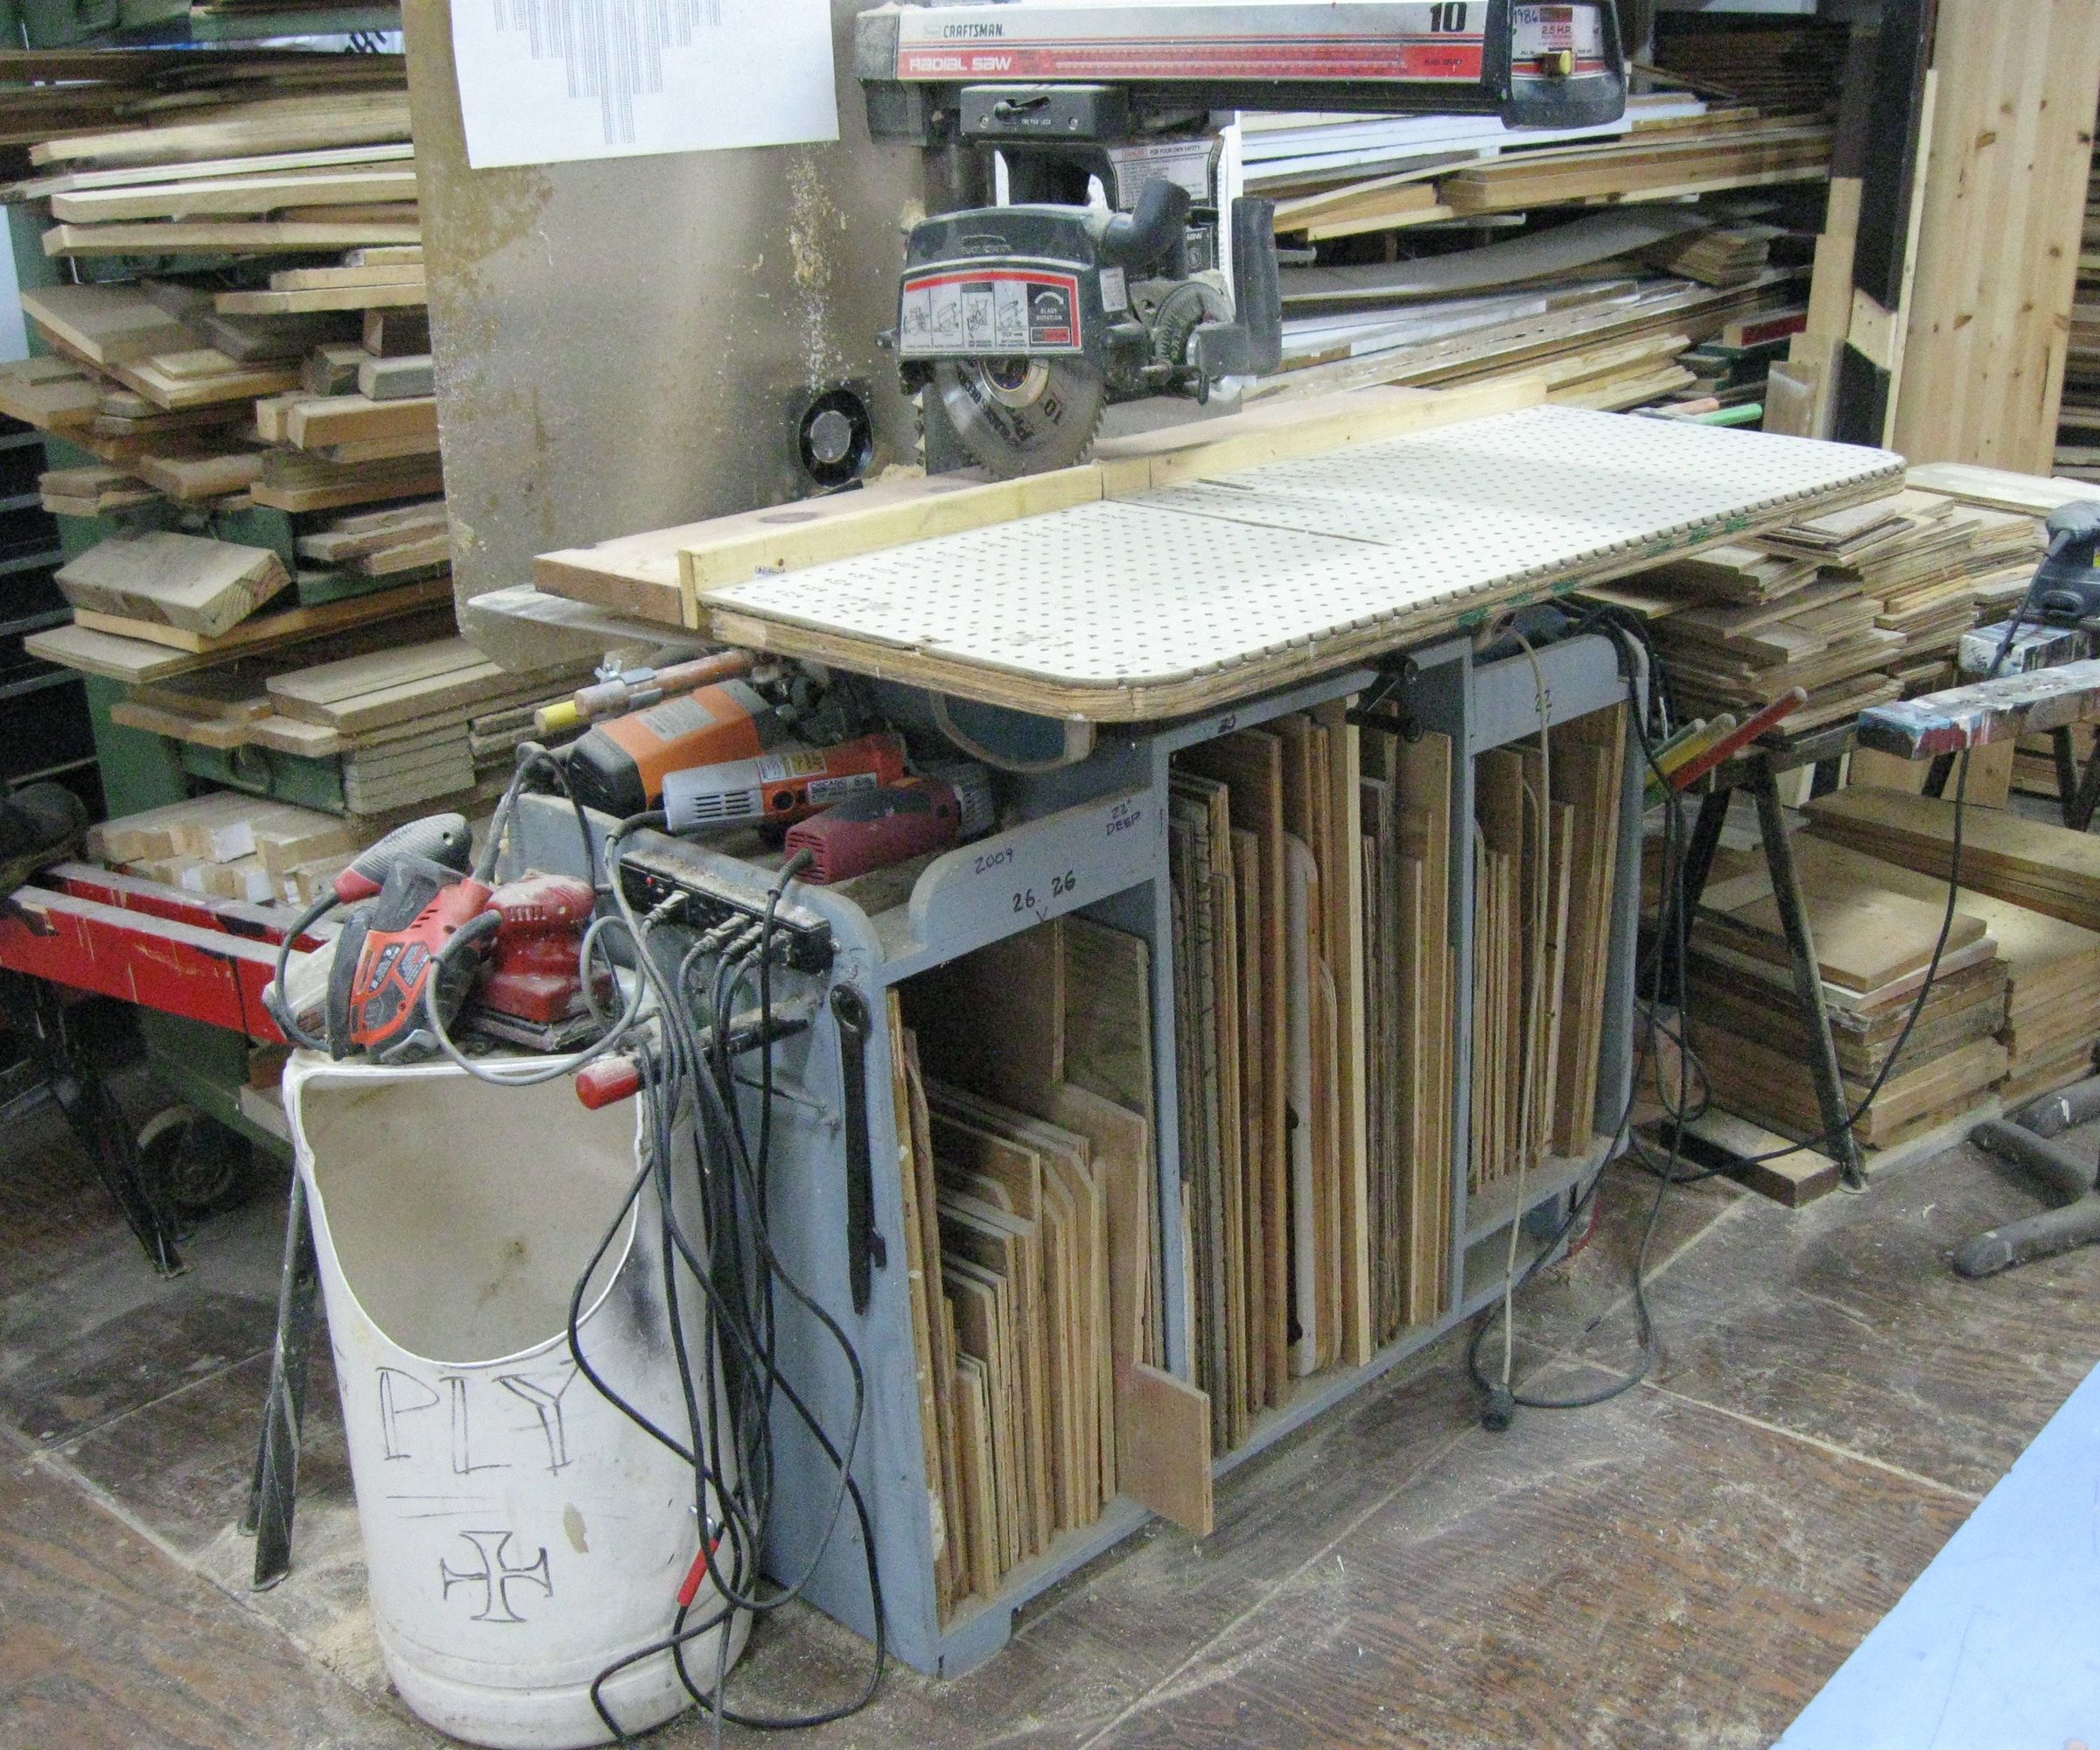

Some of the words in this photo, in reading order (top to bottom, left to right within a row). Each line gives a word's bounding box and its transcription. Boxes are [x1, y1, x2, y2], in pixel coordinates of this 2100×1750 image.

[1429, 4, 1467, 32] 10
[1511, 8, 1539, 24] 1986
[943, 23, 1003, 38] CRAFTSMAN
[1106, 811, 1142, 836] DEEP
[974, 847, 1013, 875] 2009
[1012, 888, 1036, 914] 26
[1052, 869, 1077, 899] 26
[375, 1357, 581, 1477] PLY
